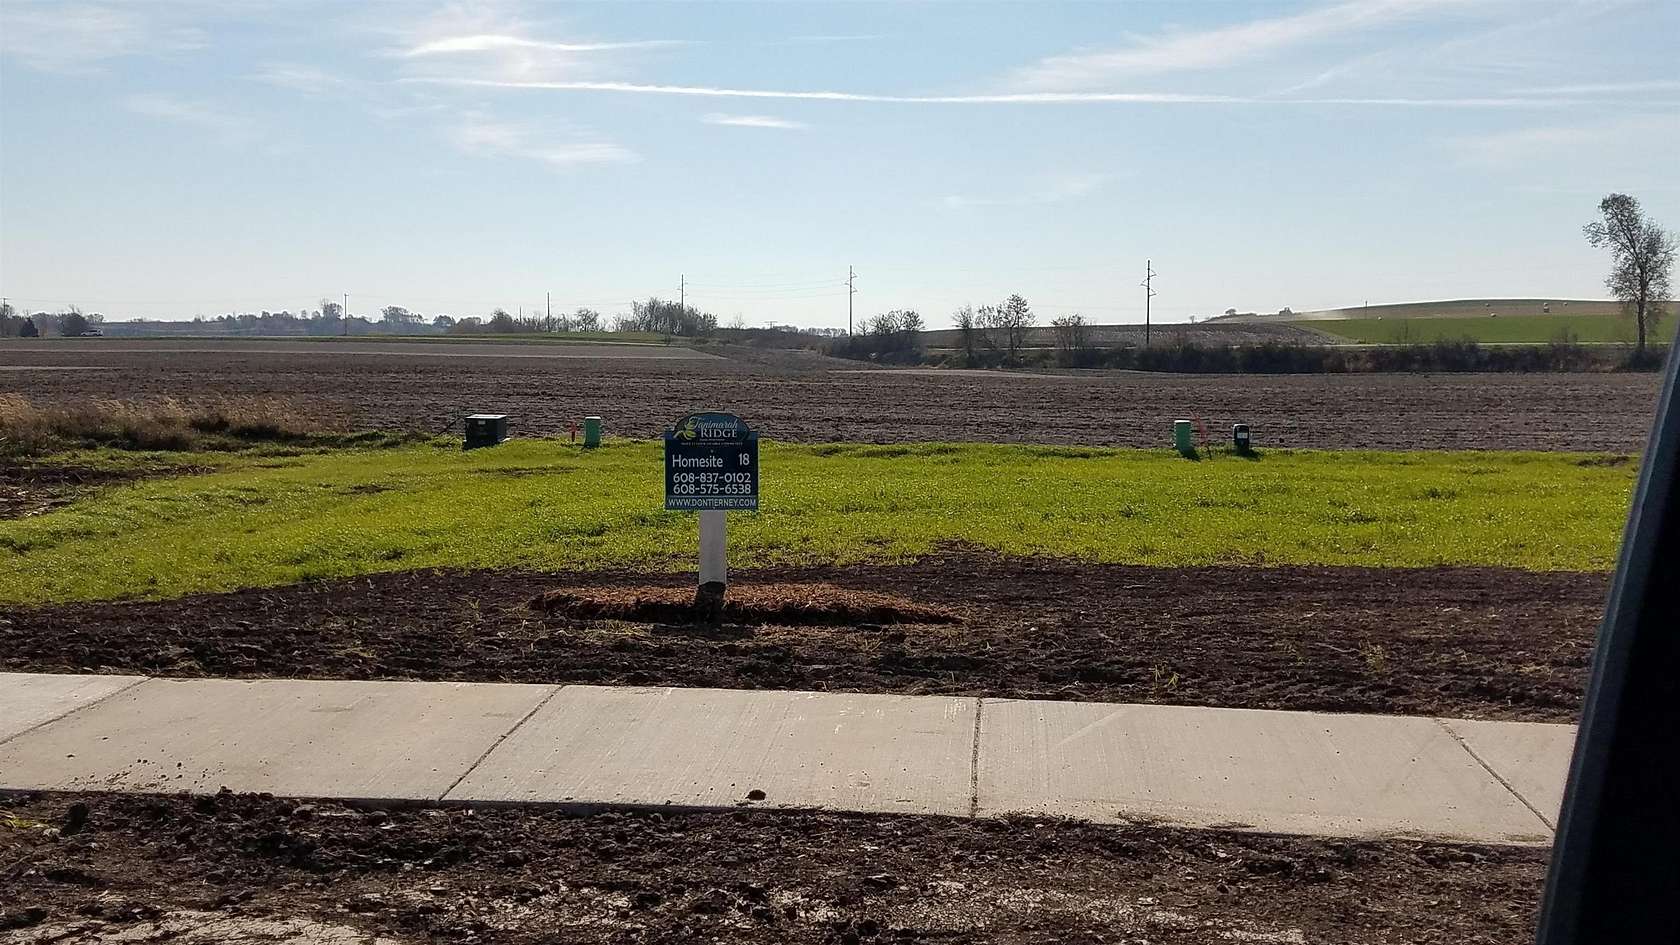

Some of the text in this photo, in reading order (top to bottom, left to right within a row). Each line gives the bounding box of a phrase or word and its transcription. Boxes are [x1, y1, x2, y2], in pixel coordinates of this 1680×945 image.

[701, 428, 738, 438] RIDGE
[672, 453, 750, 468] Homesite 18
[673, 473, 751, 483] 608-837-0102
[673, 484, 751, 494] 608-575-6538
[668, 498, 756, 507] WWW.DONTIERNEY.COM
